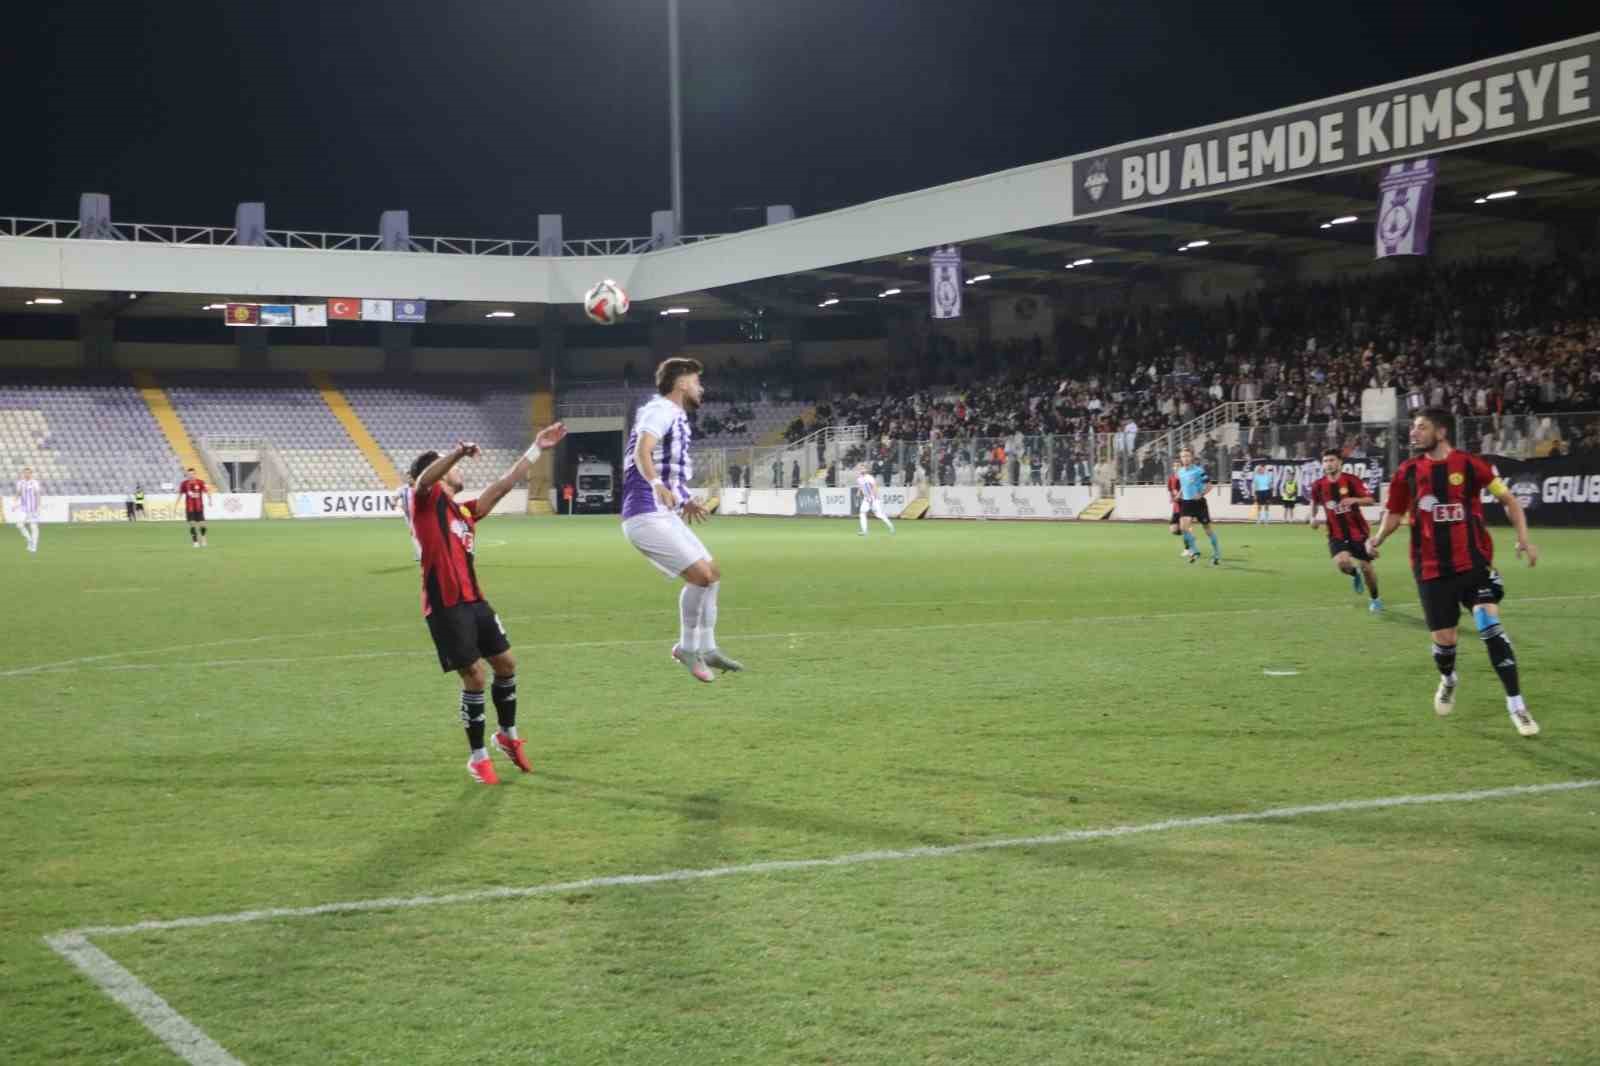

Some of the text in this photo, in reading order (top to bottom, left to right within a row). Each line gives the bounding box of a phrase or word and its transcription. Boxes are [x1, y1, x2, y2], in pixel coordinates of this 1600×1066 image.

[1121, 54, 1591, 200] BU ALEMDE KİMSEYE
